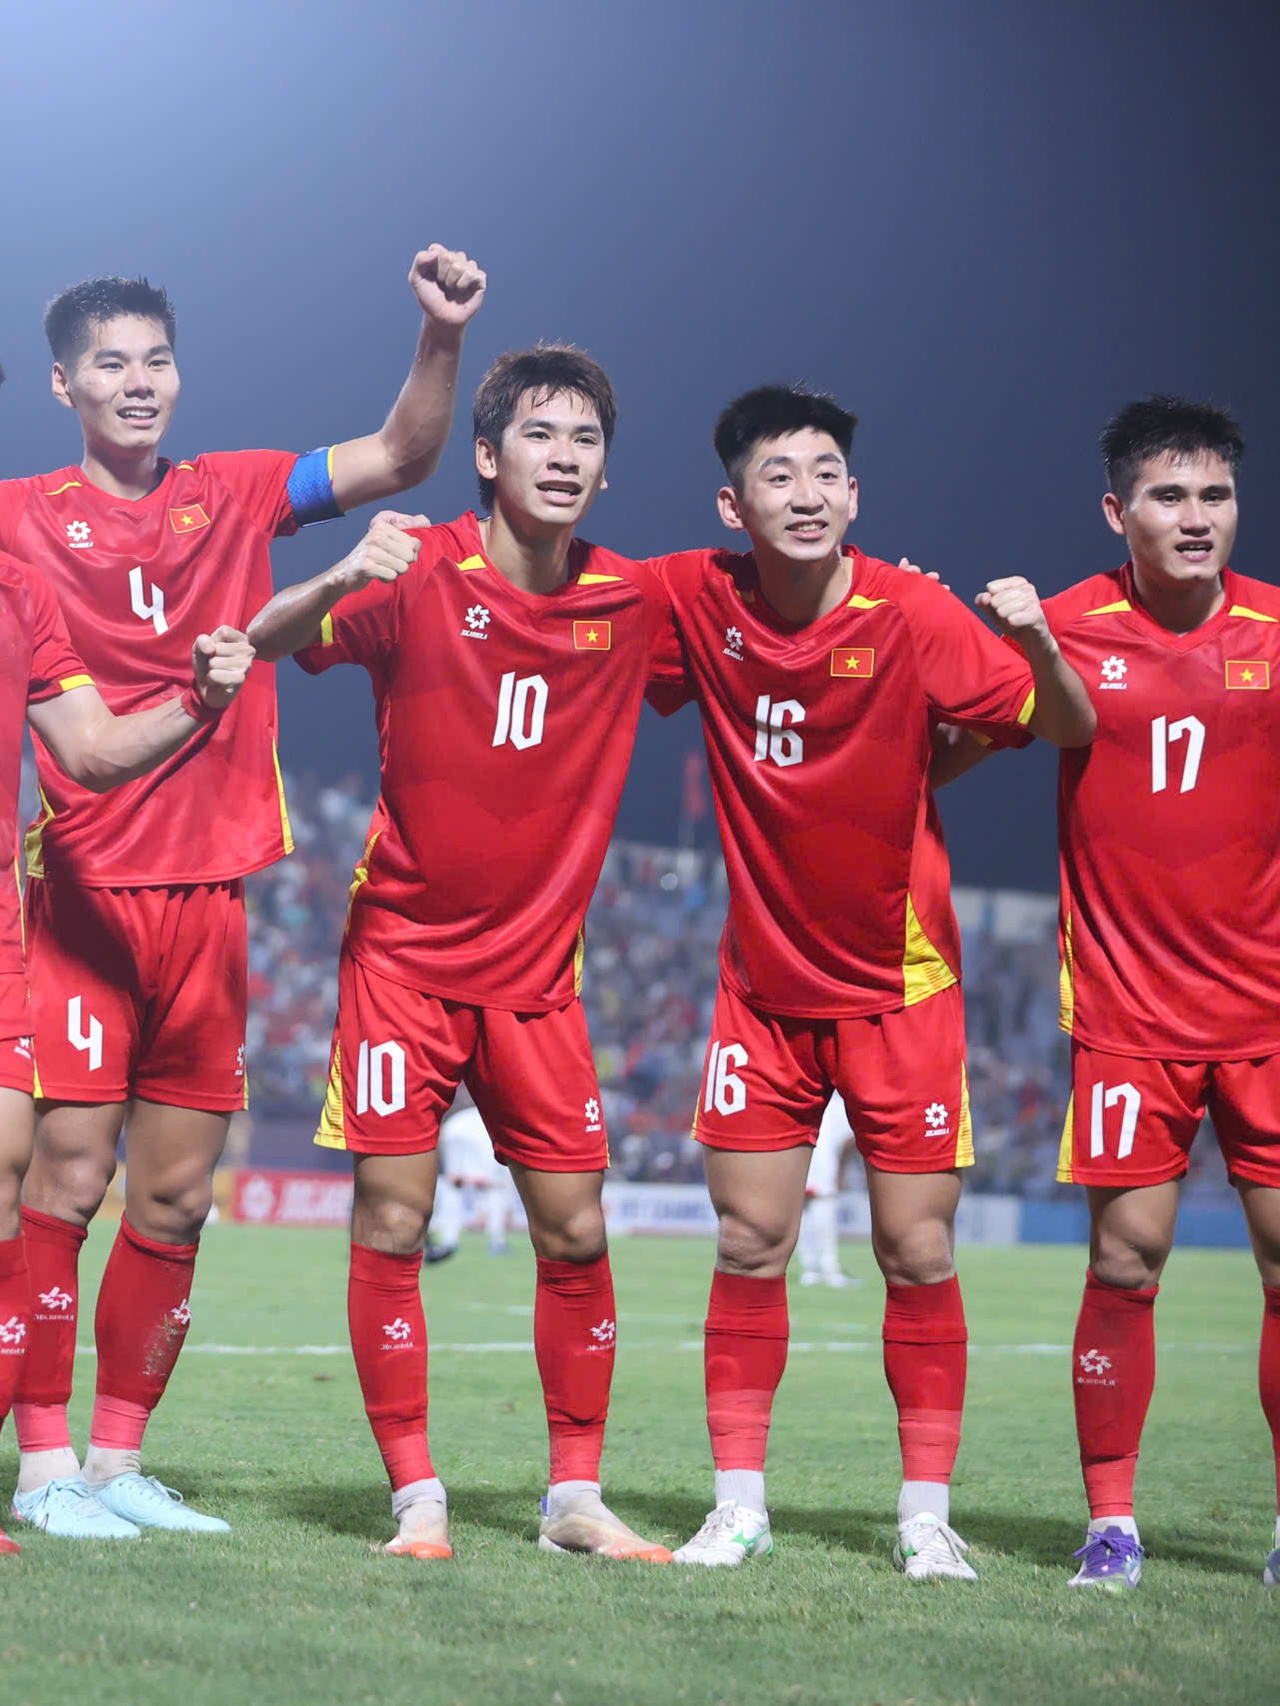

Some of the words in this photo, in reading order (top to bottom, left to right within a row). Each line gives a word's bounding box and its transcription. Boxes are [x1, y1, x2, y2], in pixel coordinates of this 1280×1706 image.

[128, 565, 170, 636] 4
[491, 671, 549, 751] 10
[753, 694, 807, 767] 16
[1151, 715, 1206, 794] 17
[67, 995, 103, 1072] 4
[356, 1039, 406, 1117] 10
[704, 1040, 749, 1116] 16
[1090, 1081, 1141, 1160] 17
